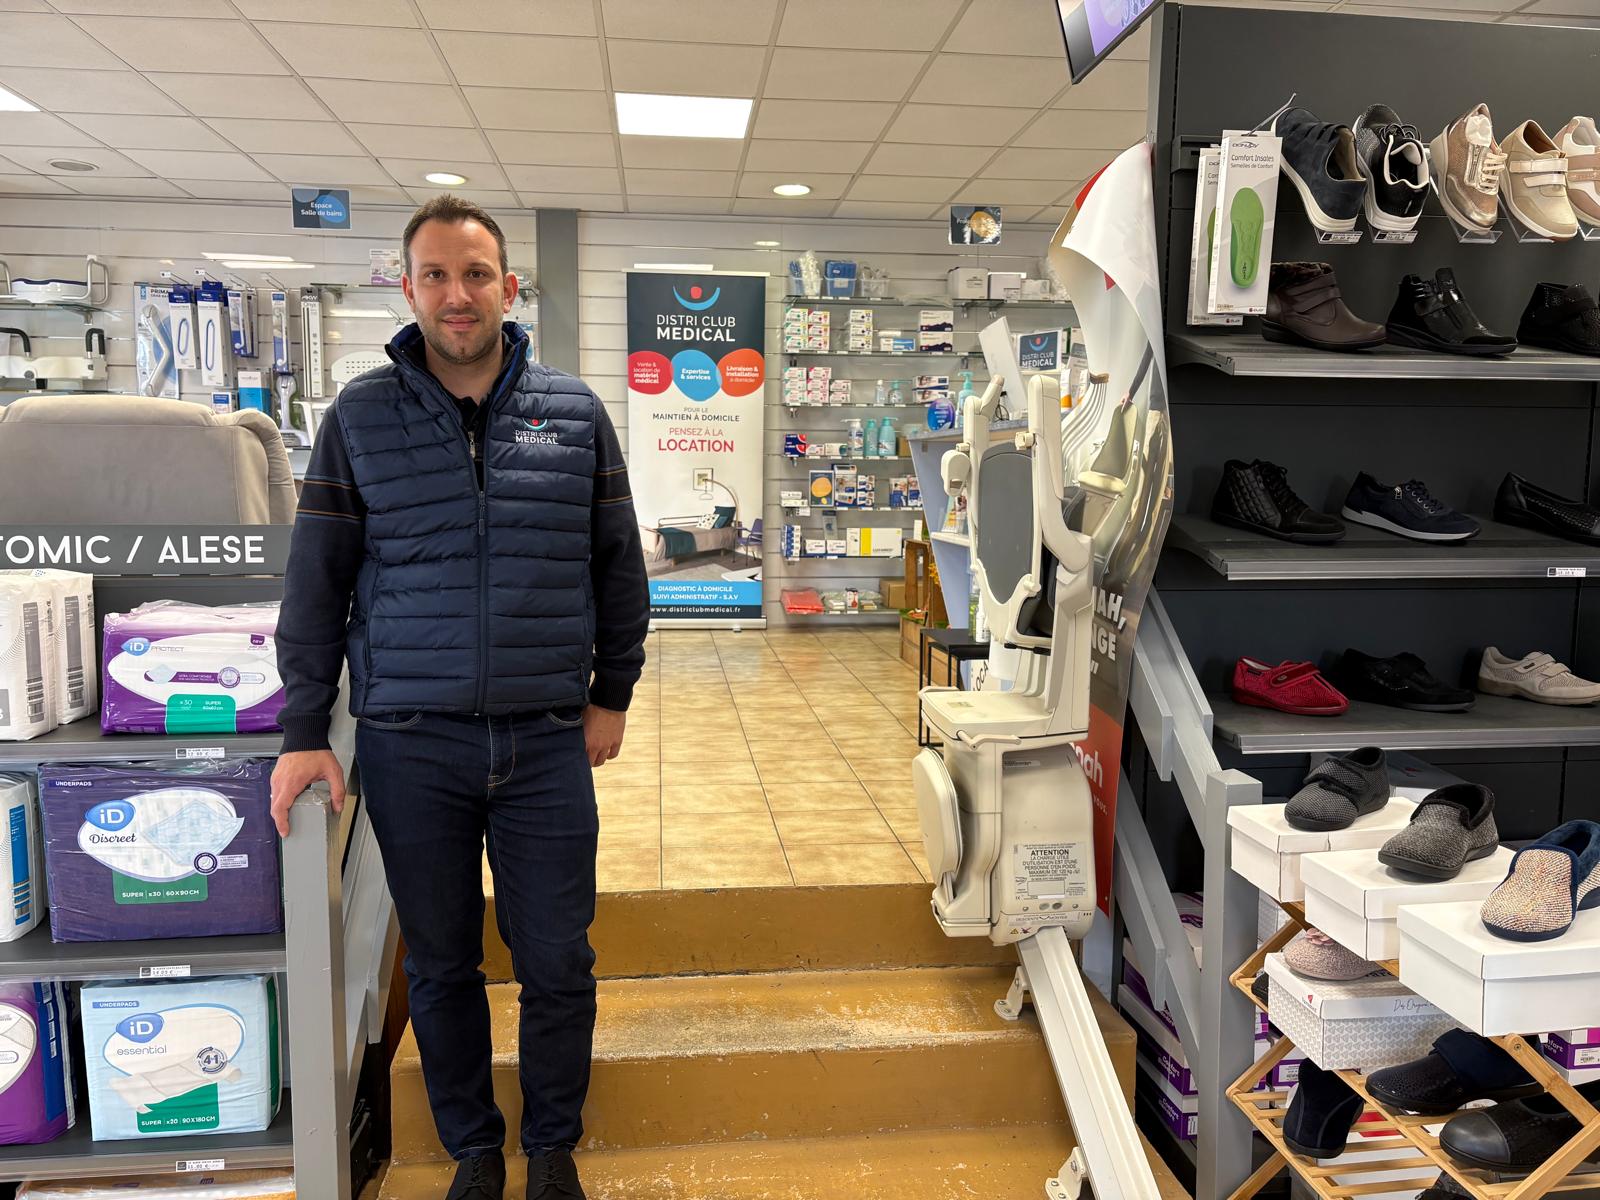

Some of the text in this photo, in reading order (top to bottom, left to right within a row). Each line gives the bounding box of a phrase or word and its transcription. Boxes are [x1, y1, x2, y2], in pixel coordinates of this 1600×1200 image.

[657, 314, 736, 327] DISTRI CLUB
[656, 327, 736, 342] MEDICAL
[1022, 358, 1054, 368] MEDICAL
[681, 368, 710, 376] Expertise
[652, 412, 740, 422] MAINTIEN À DOMICILE
[669, 426, 724, 436] PENSEZ À LA
[515, 436, 559, 444] MEDICAL
[658, 438, 735, 453] LOCATION
[0, 535, 111, 564] OMIC
[158, 535, 265, 564] ALESE
[129, 643, 144, 652] iD
[1069, 742, 1103, 788] nah
[100, 808, 125, 824] iD
[89, 833, 137, 844] Discreet
[129, 1021, 154, 1036] iD
[116, 1045, 167, 1056] essential
